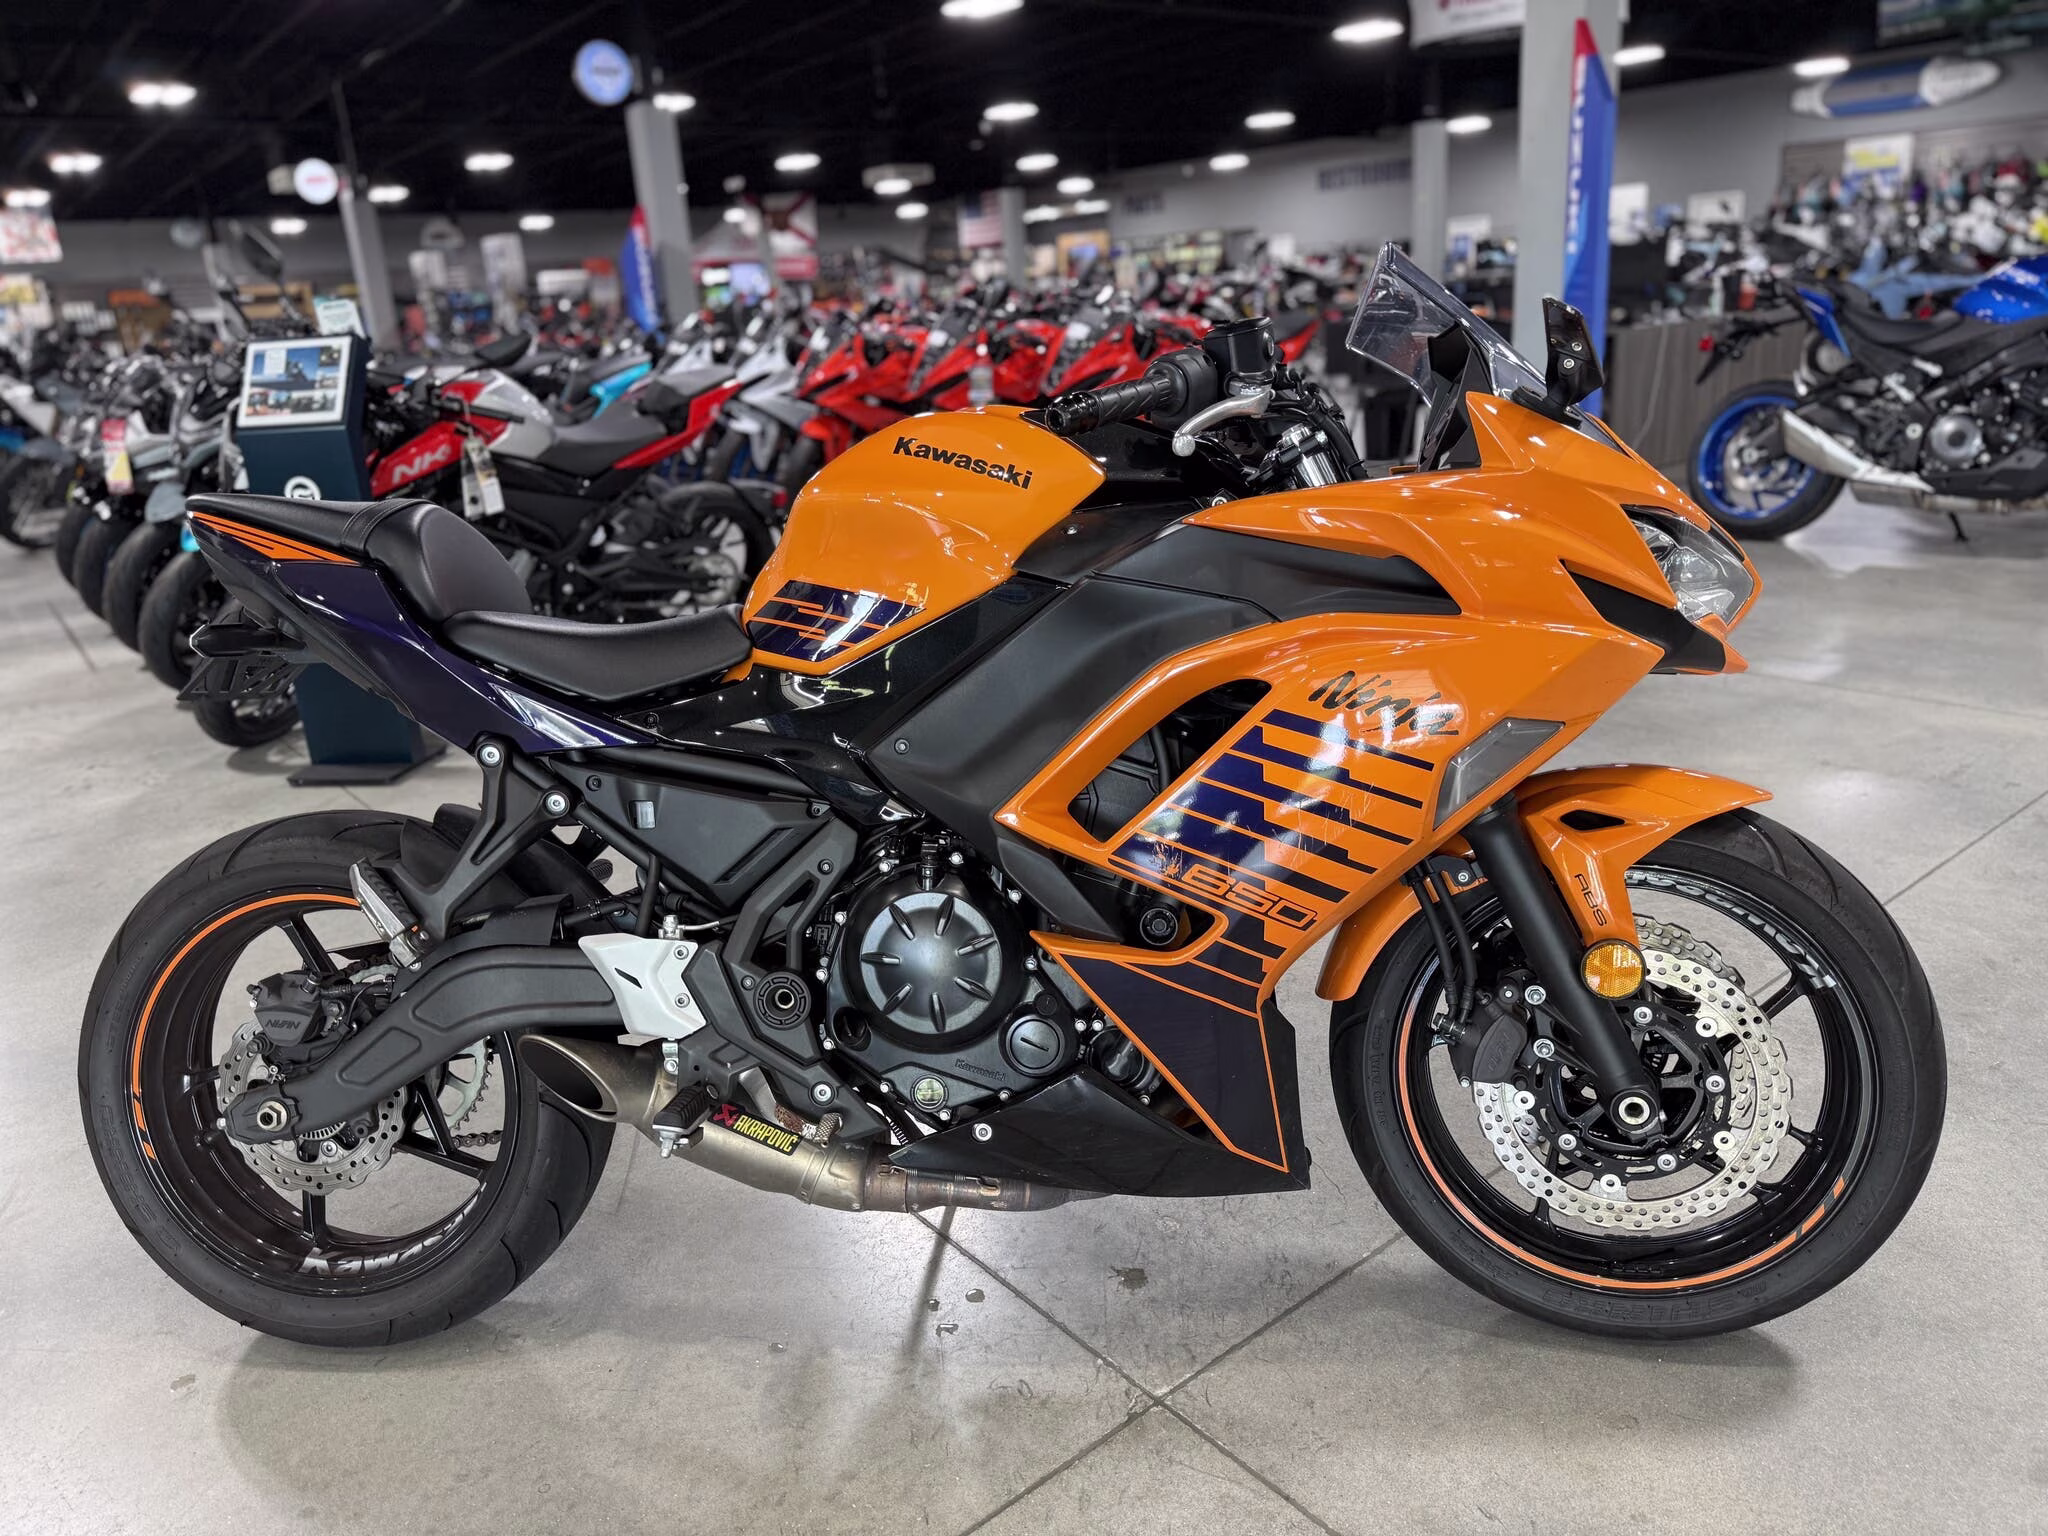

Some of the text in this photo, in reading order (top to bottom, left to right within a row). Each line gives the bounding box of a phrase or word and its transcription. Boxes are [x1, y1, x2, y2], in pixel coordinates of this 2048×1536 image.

[392, 444, 451, 484] NK
[893, 436, 1033, 490] Kawasaki
[1308, 670, 1459, 736] Ninja
[1181, 863, 1318, 931] 650
[1574, 873, 1608, 927] ABS
[1625, 870, 1837, 989] Kawasa
[954, 1058, 1007, 1082] Kawasaki
